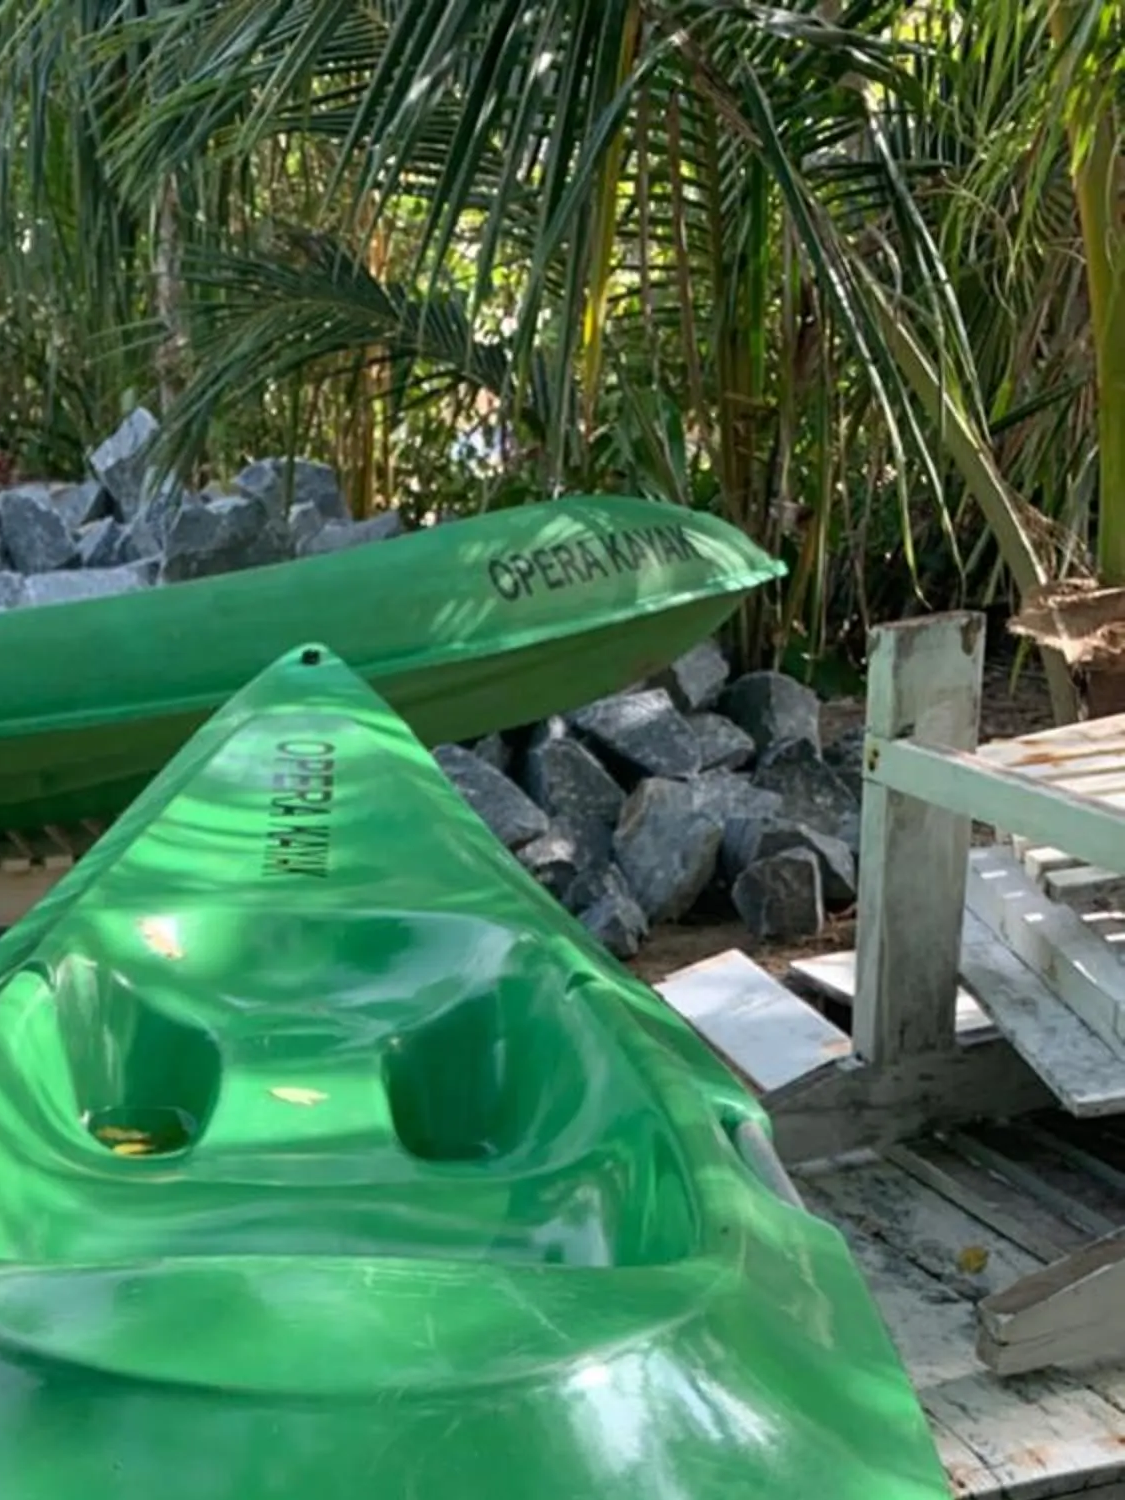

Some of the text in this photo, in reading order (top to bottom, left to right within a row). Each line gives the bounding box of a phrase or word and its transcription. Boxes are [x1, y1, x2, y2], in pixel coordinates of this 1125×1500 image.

[488, 523, 704, 602] OPERA KAYAK
[268, 740, 336, 817] OPERA
